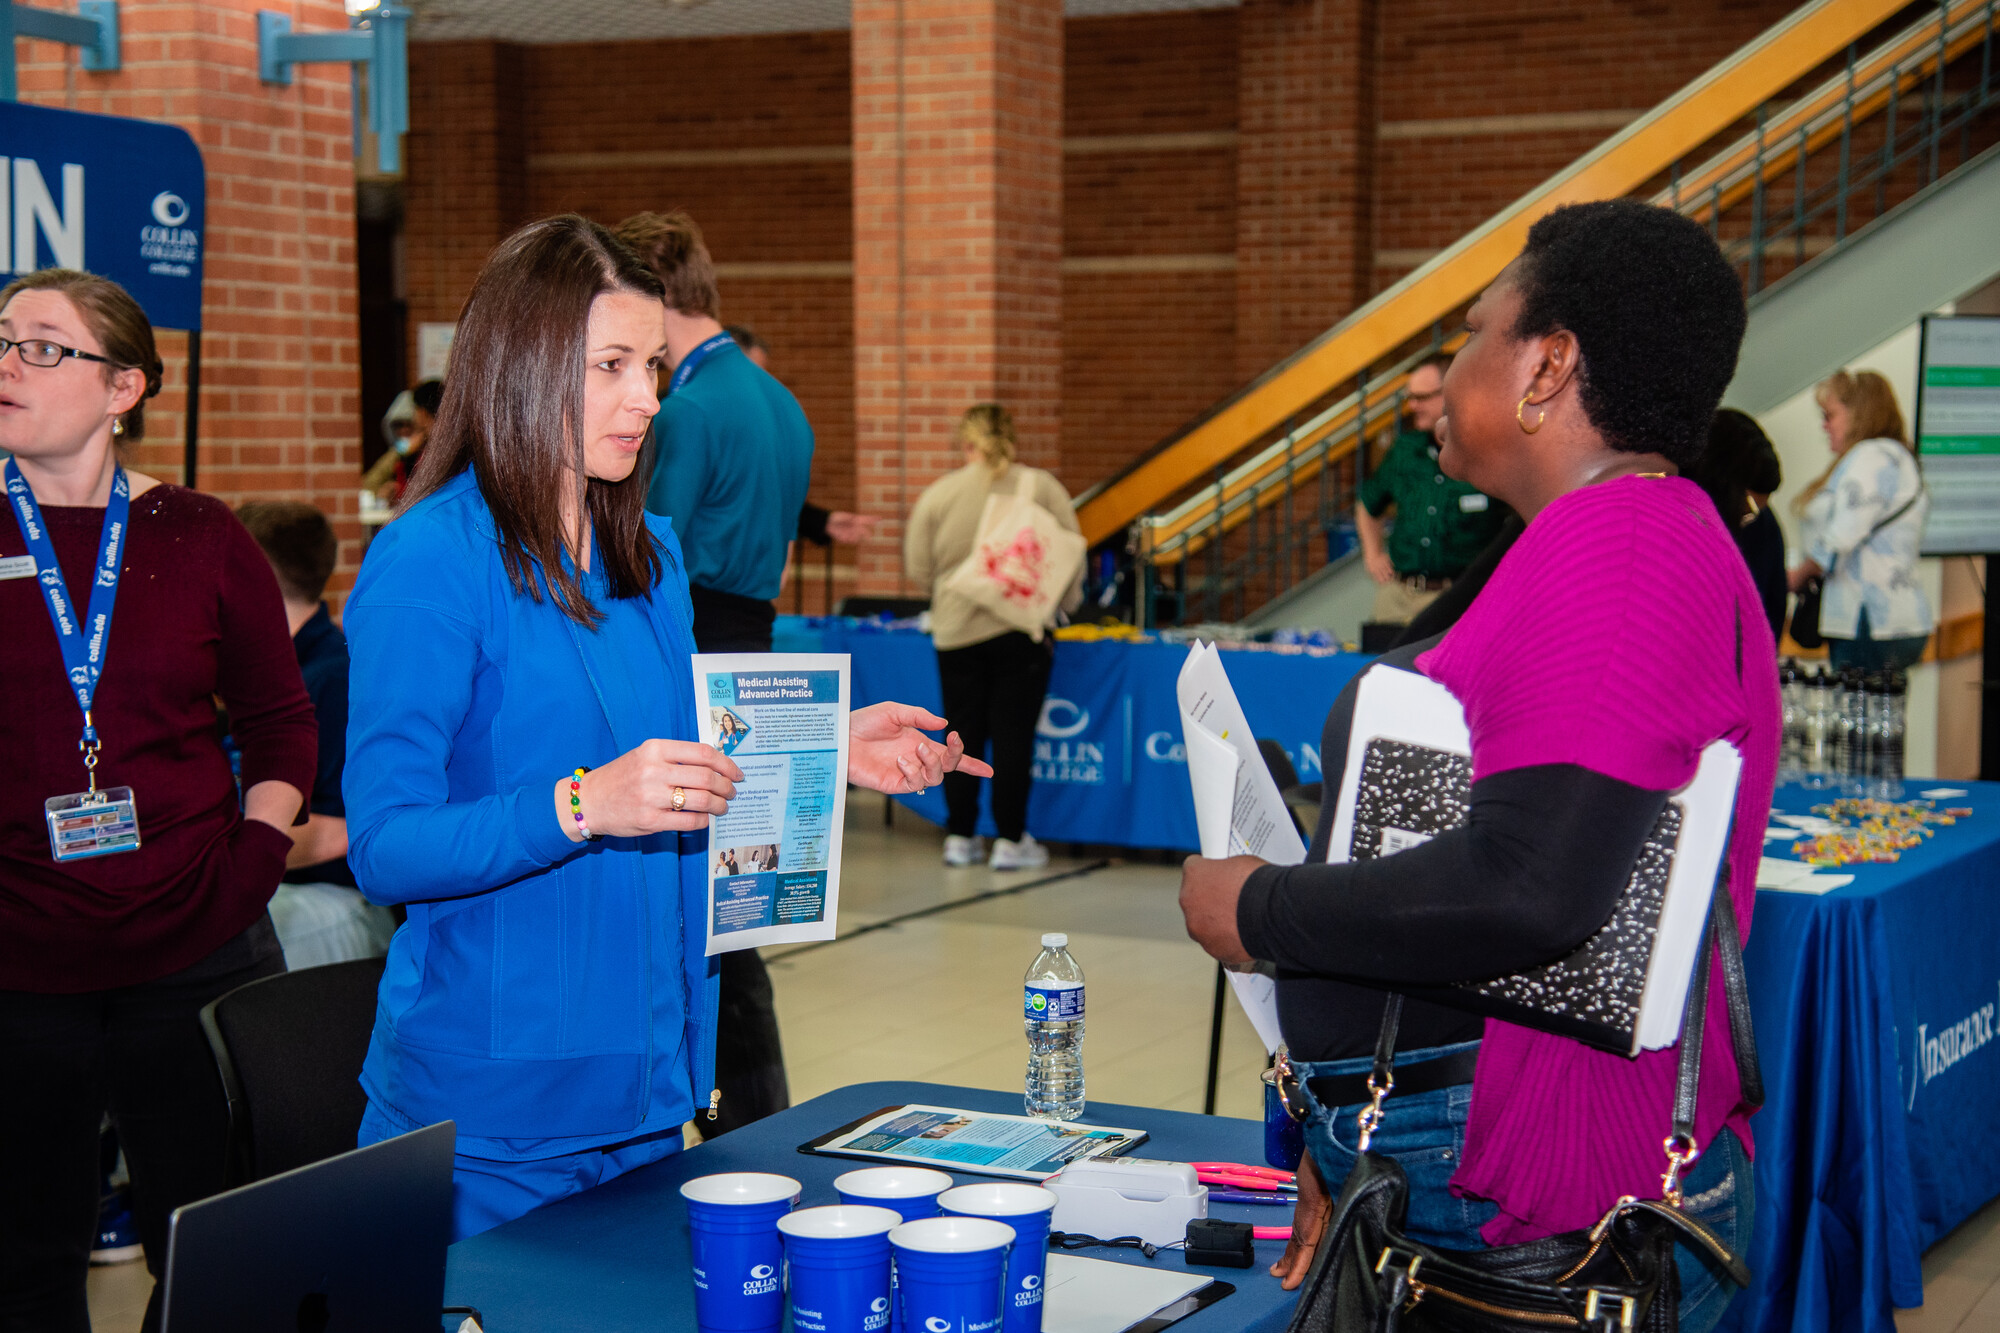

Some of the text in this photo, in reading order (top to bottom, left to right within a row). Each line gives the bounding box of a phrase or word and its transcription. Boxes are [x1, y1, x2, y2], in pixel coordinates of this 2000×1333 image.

[141, 225, 198, 246] COLLIN
[16, 495, 41, 541] collin.edu
[106, 522, 122, 568] collin.edu
[49, 588, 73, 636] collin.edu
[89, 613, 107, 663] collin.edu
[738, 677, 808, 688] Medical Assisting
[739, 688, 813, 700] Advanced Practice
[1918, 1002, 1994, 1087] Insurance
[744, 1277, 778, 1290] COLLIN
[744, 1285, 777, 1296] COLLEGE
[1015, 1287, 1043, 1301] COLLIN
[1015, 1295, 1042, 1307] COLLEGE
[798, 1307, 822, 1320] Assisting
[864, 1310, 890, 1324] COLLIN
[802, 1320, 826, 1331] Practice
[968, 1320, 994, 1332] Medical
